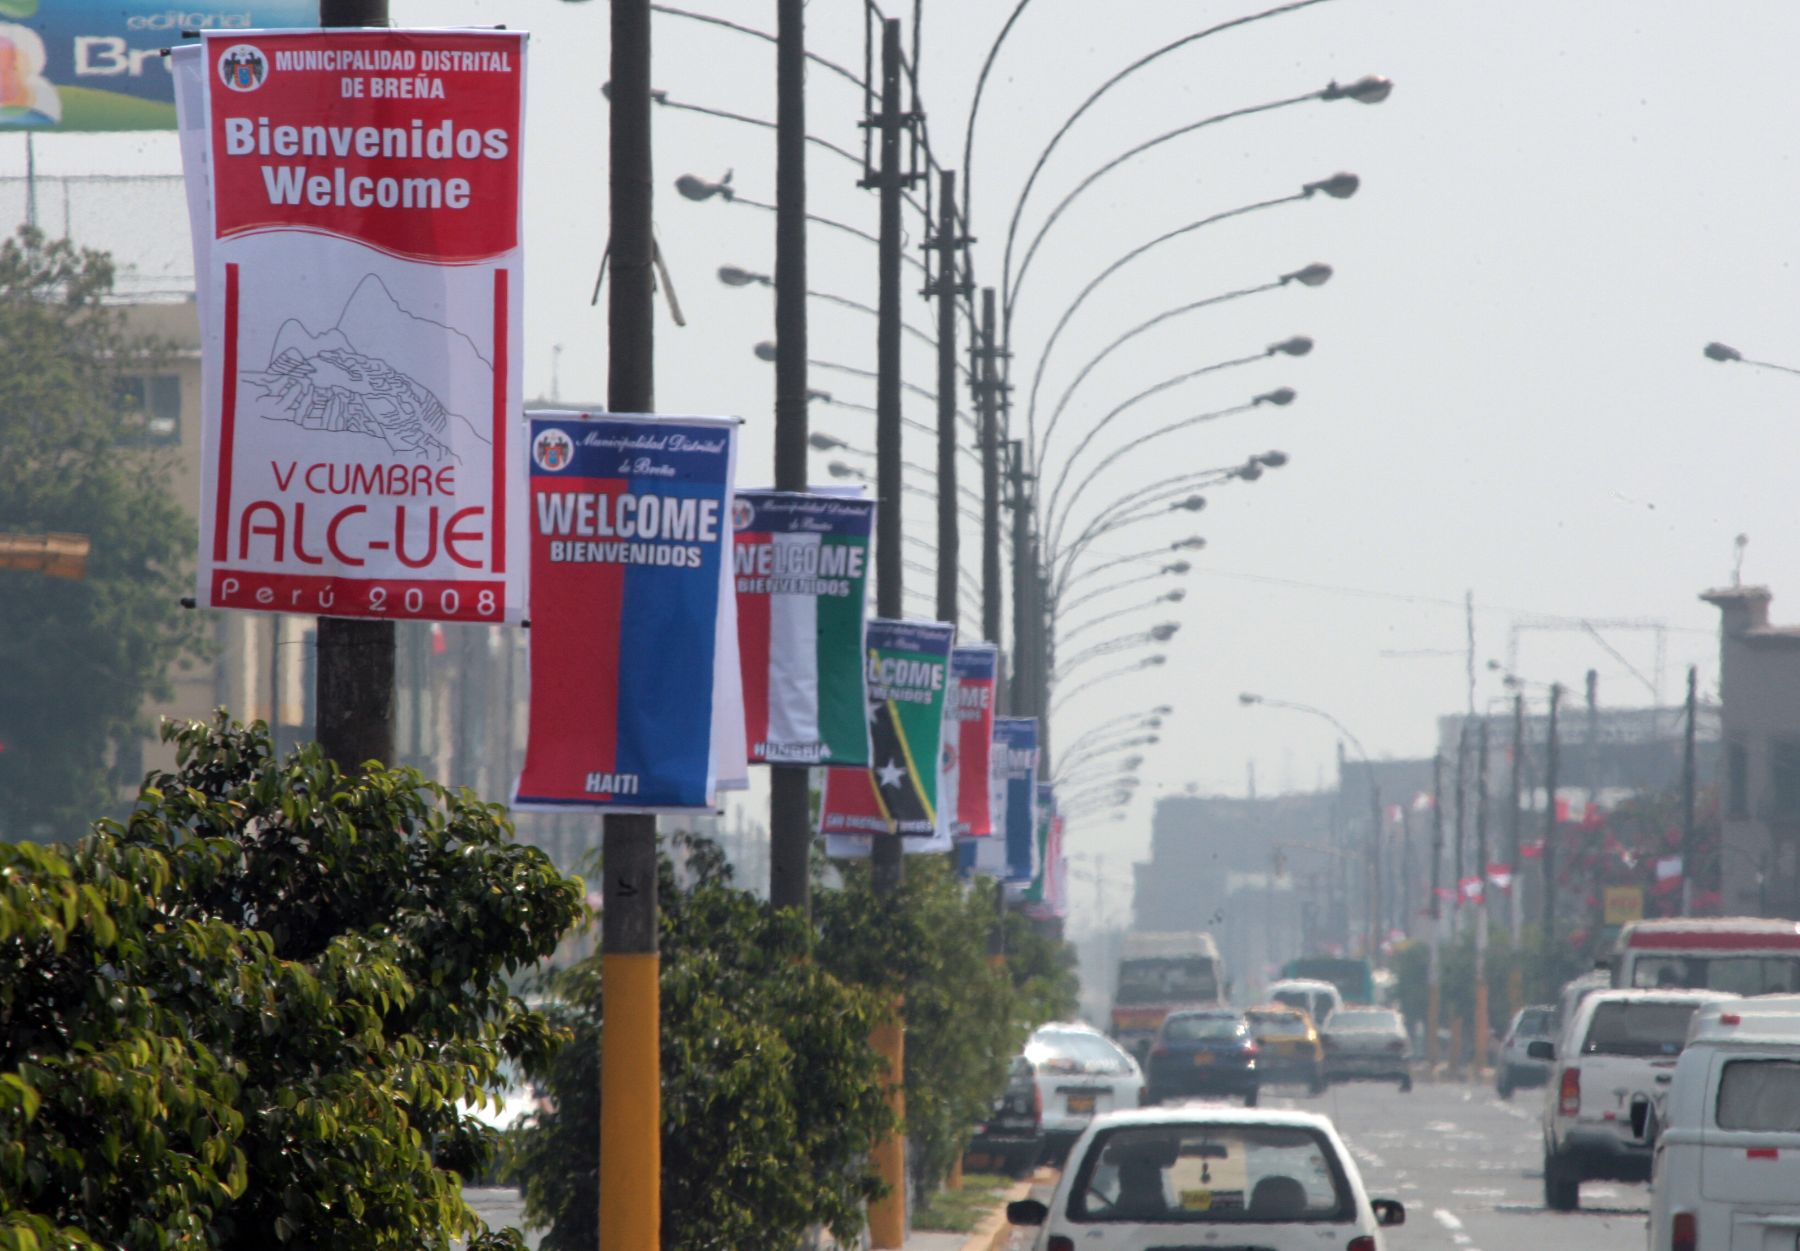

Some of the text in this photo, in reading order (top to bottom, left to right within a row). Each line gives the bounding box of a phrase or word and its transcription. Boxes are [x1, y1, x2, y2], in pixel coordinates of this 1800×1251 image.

[275, 50, 512, 73] MUNICIPALIDAD DISTRITAL
[340, 75, 446, 100] DE BREÑA
[224, 117, 509, 160] Bienvenidos
[261, 166, 471, 208] Welcome
[576, 431, 726, 454] Municipalidad Distrital
[271, 460, 456, 497] V CUMBRE
[536, 491, 720, 542] WELCOME
[238, 500, 486, 569] ALC-UE
[549, 541, 702, 568] BIENVENIDOS
[221, 578, 496, 615] Perú 2008
[737, 577, 850, 597] BIENVENIDOS
[868, 655, 945, 690] LCOME
[585, 772, 638, 794] HAITI
